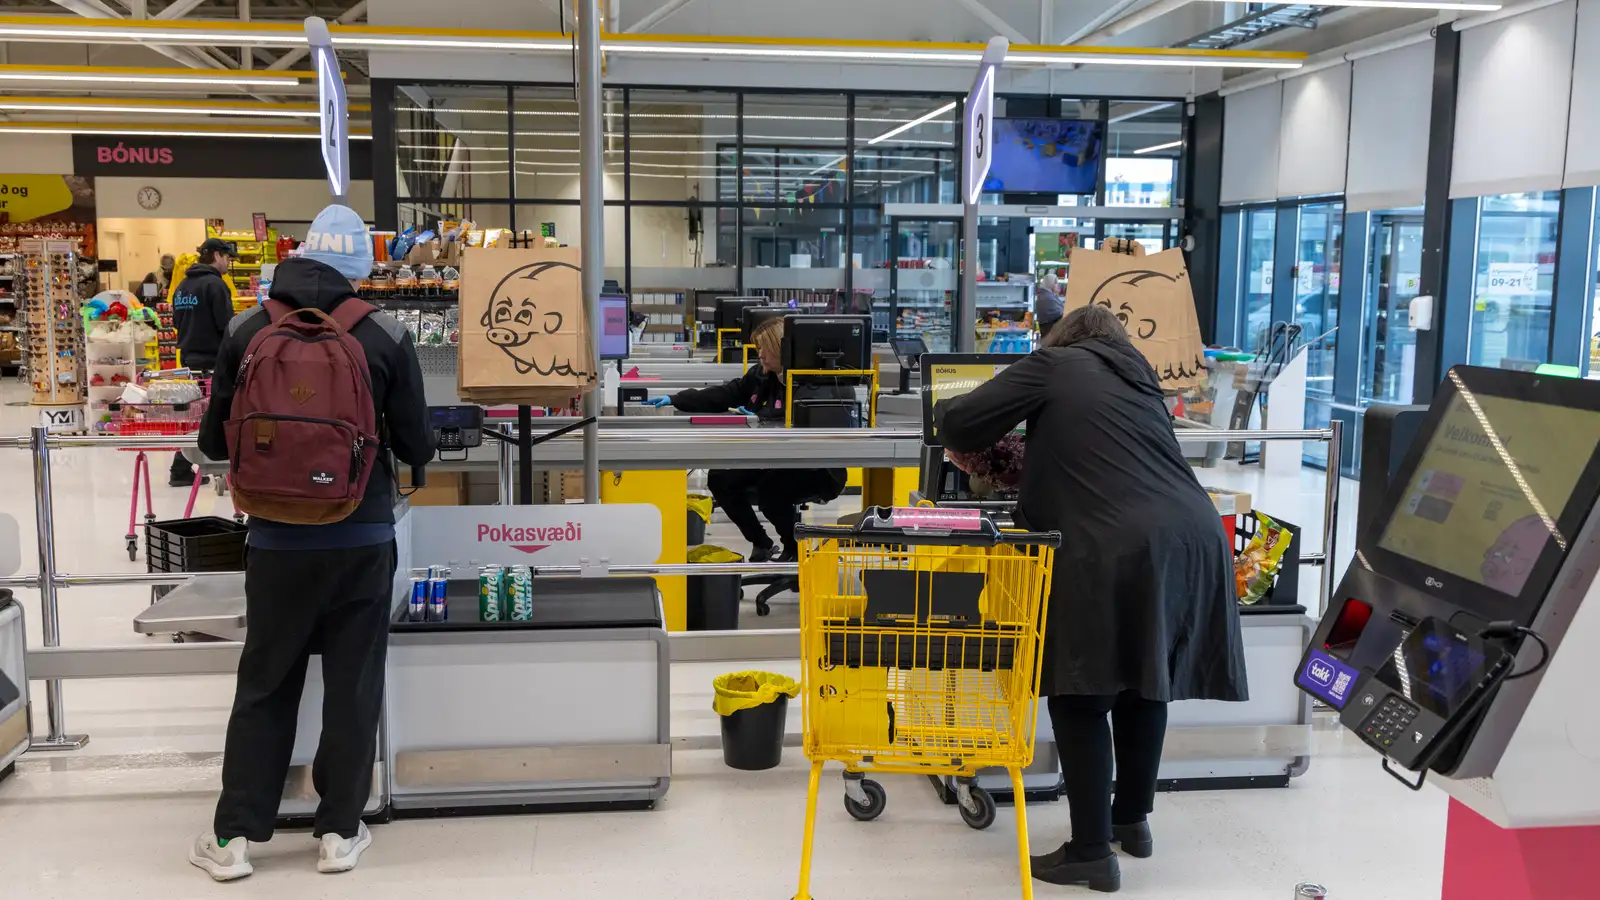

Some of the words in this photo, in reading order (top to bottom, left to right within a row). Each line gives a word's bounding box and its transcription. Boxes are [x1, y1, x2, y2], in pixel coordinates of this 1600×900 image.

[328, 99, 336, 147] 2
[976, 112, 984, 159] 3
[97, 141, 173, 164] BÓNUS
[11, 186, 28, 198] og
[1491, 278, 1521, 287] 09-21
[477, 521, 582, 542] Pokasvæði
[484, 574, 500, 622] Sprite
[511, 574, 526, 621] Sprite
[1311, 662, 1330, 683] takk
